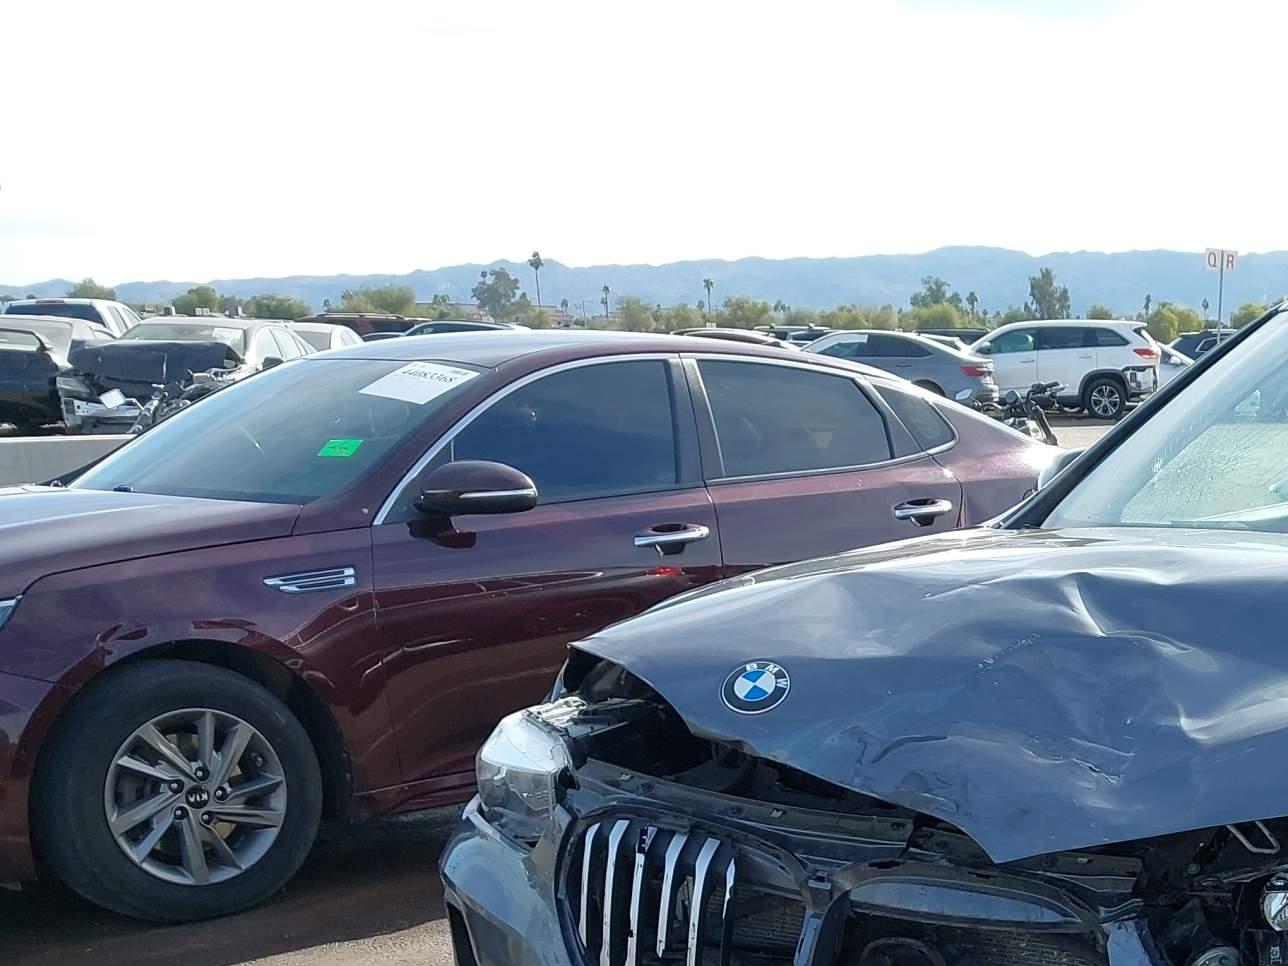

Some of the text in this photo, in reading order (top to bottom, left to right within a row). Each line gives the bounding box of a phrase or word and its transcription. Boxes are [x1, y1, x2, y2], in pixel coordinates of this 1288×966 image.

[1207, 251, 1217, 268] Q
[1226, 253, 1235, 270] R
[745, 662, 788, 689] BMW
